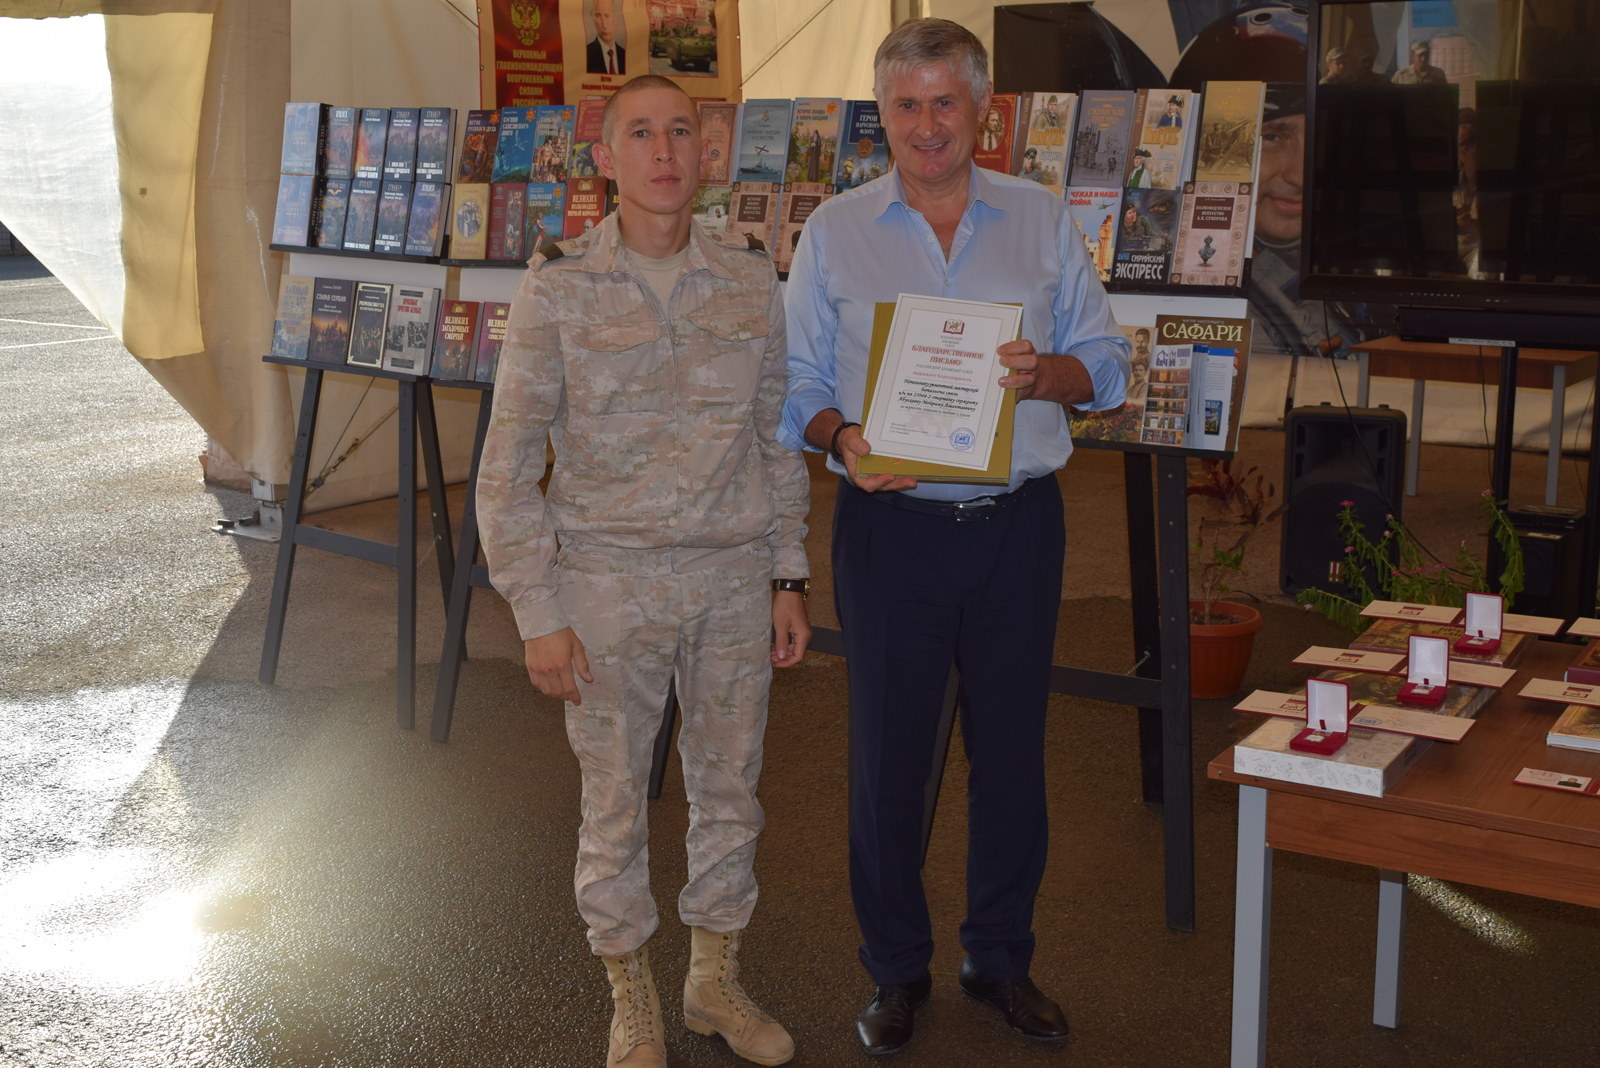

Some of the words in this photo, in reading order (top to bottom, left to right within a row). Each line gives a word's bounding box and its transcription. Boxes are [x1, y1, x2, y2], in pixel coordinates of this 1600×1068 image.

[512, 50, 546, 60] ВЕРХОВНЫЙ
[496, 61, 562, 73] ГЛАВНОКОМАНДУЮЩИЙ
[519, 86, 543, 96] СИЛАМИ
[1088, 108, 1125, 116] ОКЕАНСКИЙ
[572, 194, 598, 202] ВЕЛИКИХ
[1131, 254, 1165, 263] СИРИЙСКИЙ
[1114, 263, 1164, 280] ЭКСПРЕСС
[285, 285, 309, 296] ТАЙНЫЙ
[282, 295, 307, 312] КОД
[398, 305, 410, 313] ПРОТИВ
[445, 316, 469, 325] ВЕЛИКИХ
[488, 319, 508, 327] ВЕЛИКИ
[442, 325, 469, 333] ЗАГАДОЧНЫХ
[1162, 322, 1243, 342] САФАРИ
[445, 332, 464, 340] СМЕРТЕЙ
[911, 345, 984, 360] БЛАГОДАРСТВЕННОЕ
[930, 357, 961, 366] ПИСЬМО
[937, 373, 972, 382] благодарность
